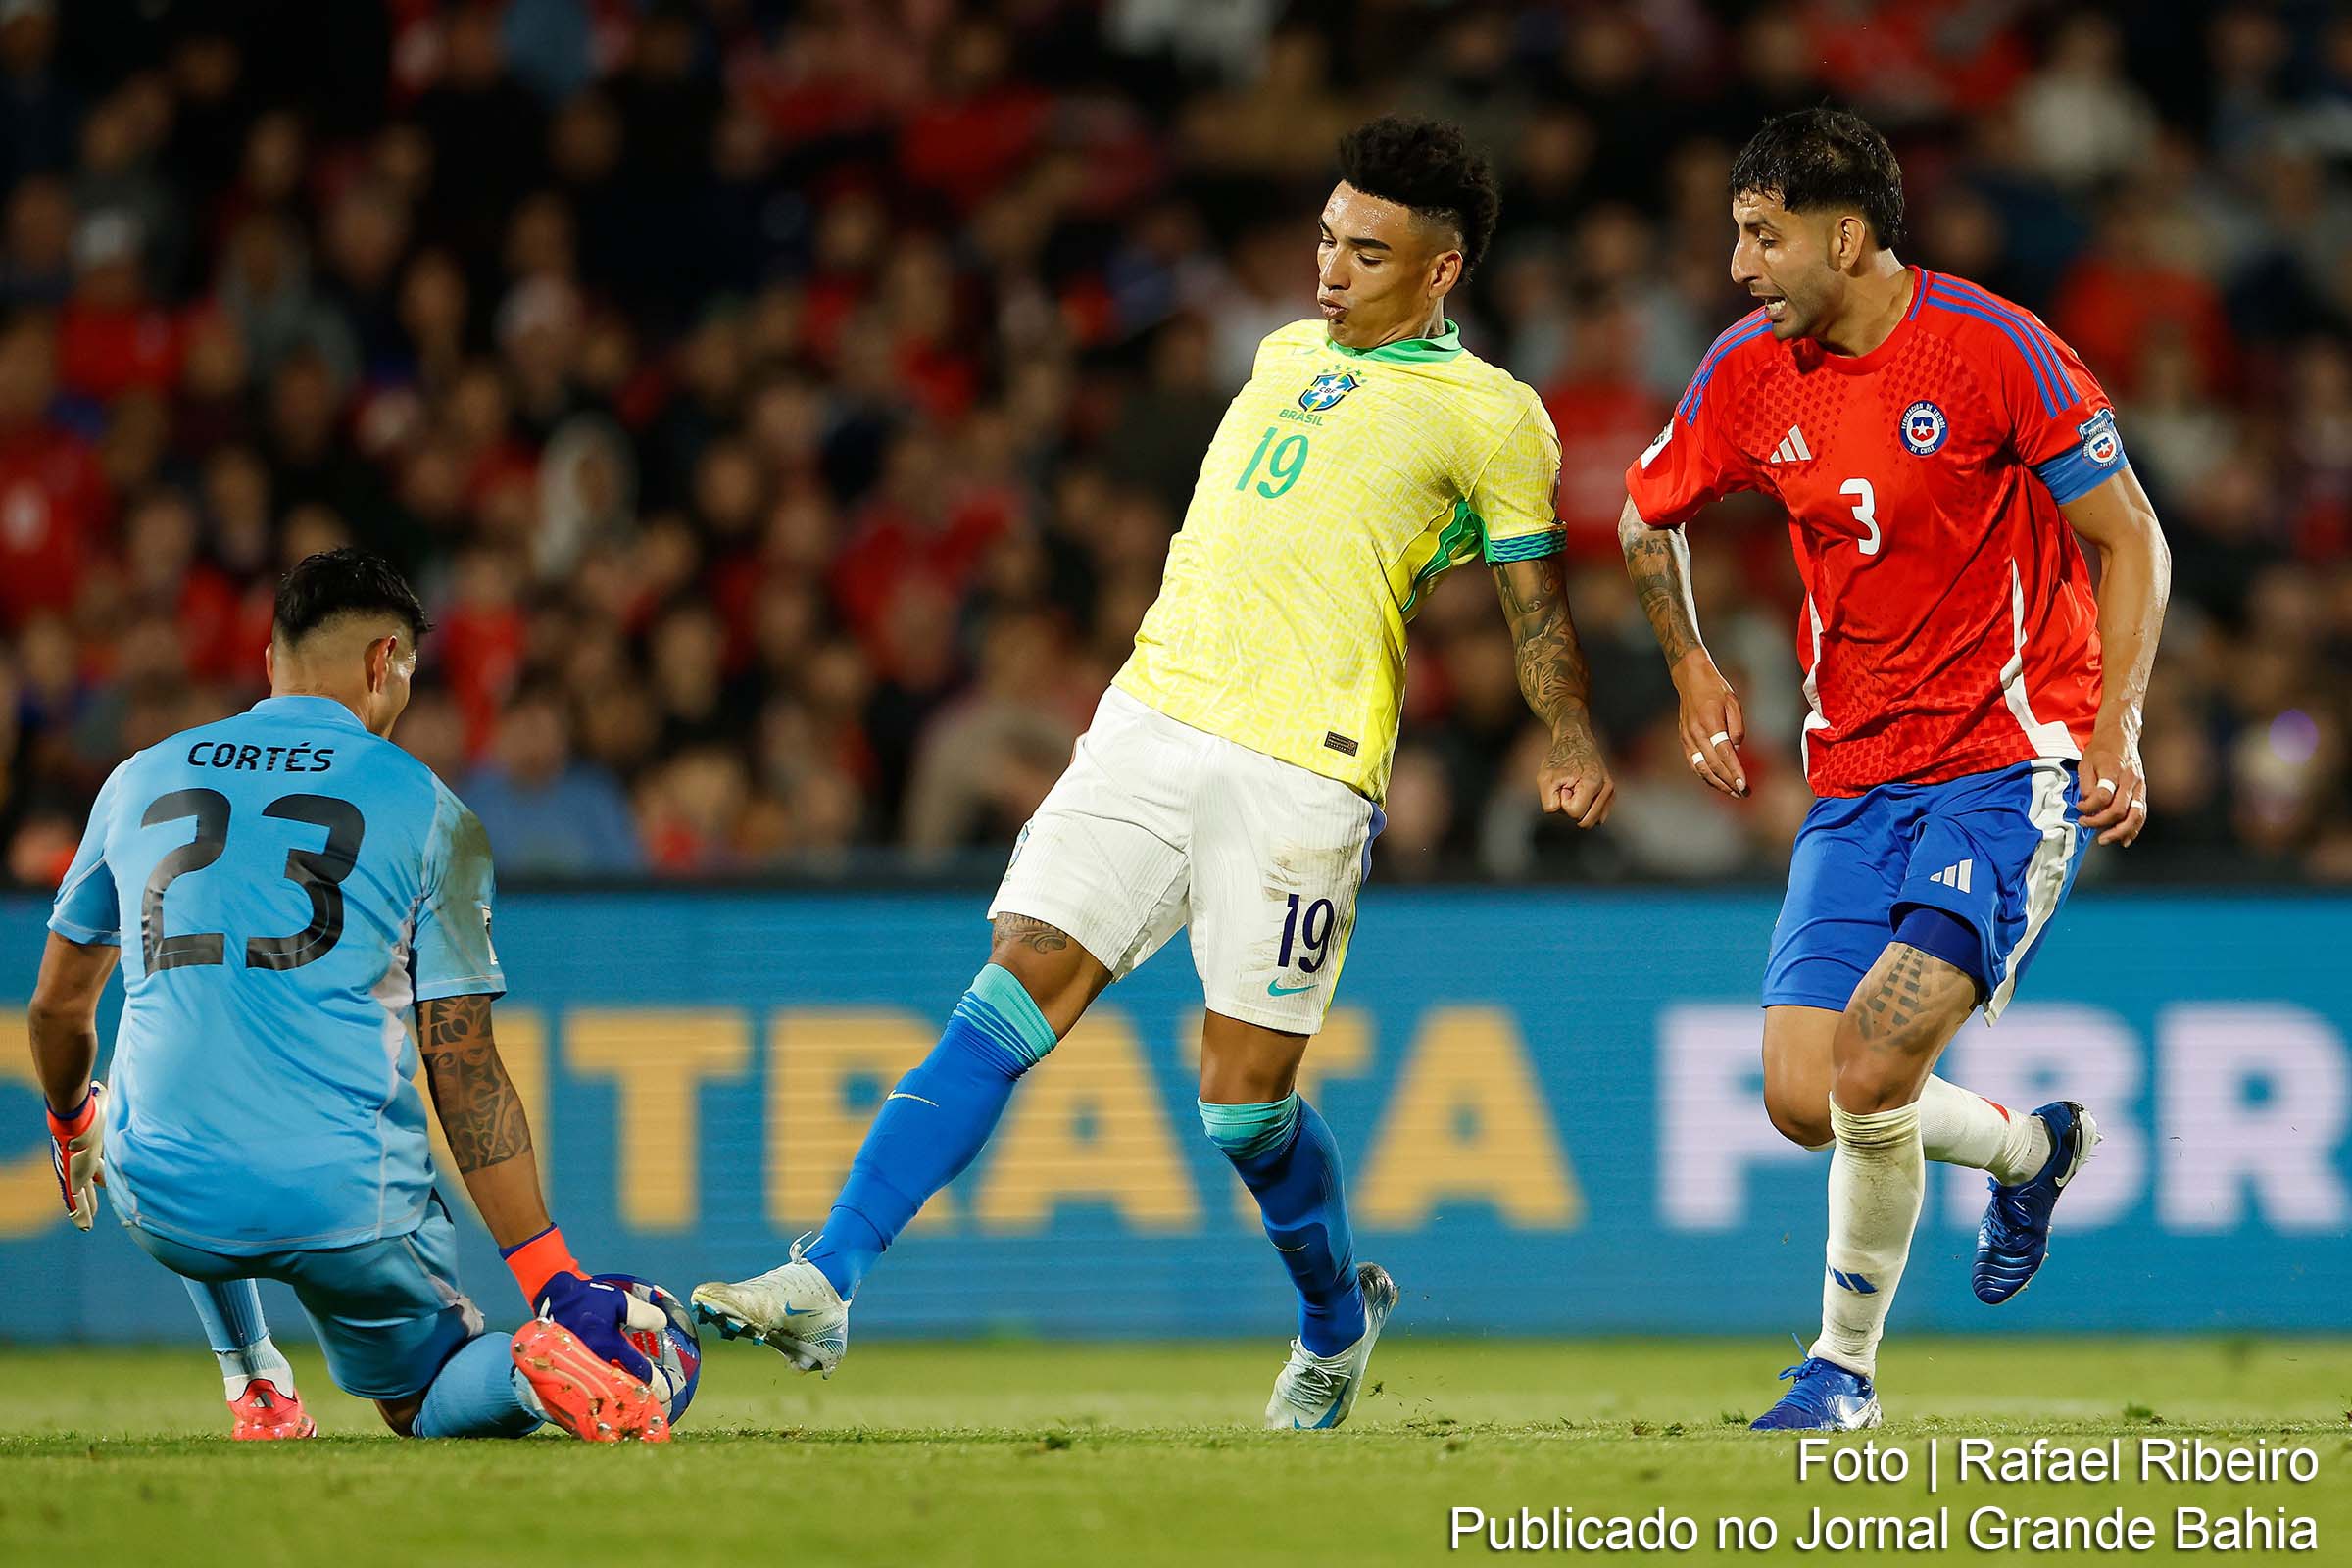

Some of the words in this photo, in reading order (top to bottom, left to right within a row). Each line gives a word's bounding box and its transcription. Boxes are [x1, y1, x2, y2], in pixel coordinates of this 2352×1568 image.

[1279, 409, 1323, 426] BRASIL
[1236, 426, 1308, 499] 19
[1839, 478, 1881, 556] 3
[187, 742, 334, 772] CORTÉS
[140, 787, 366, 979] 23
[1277, 893, 1335, 973] 19
